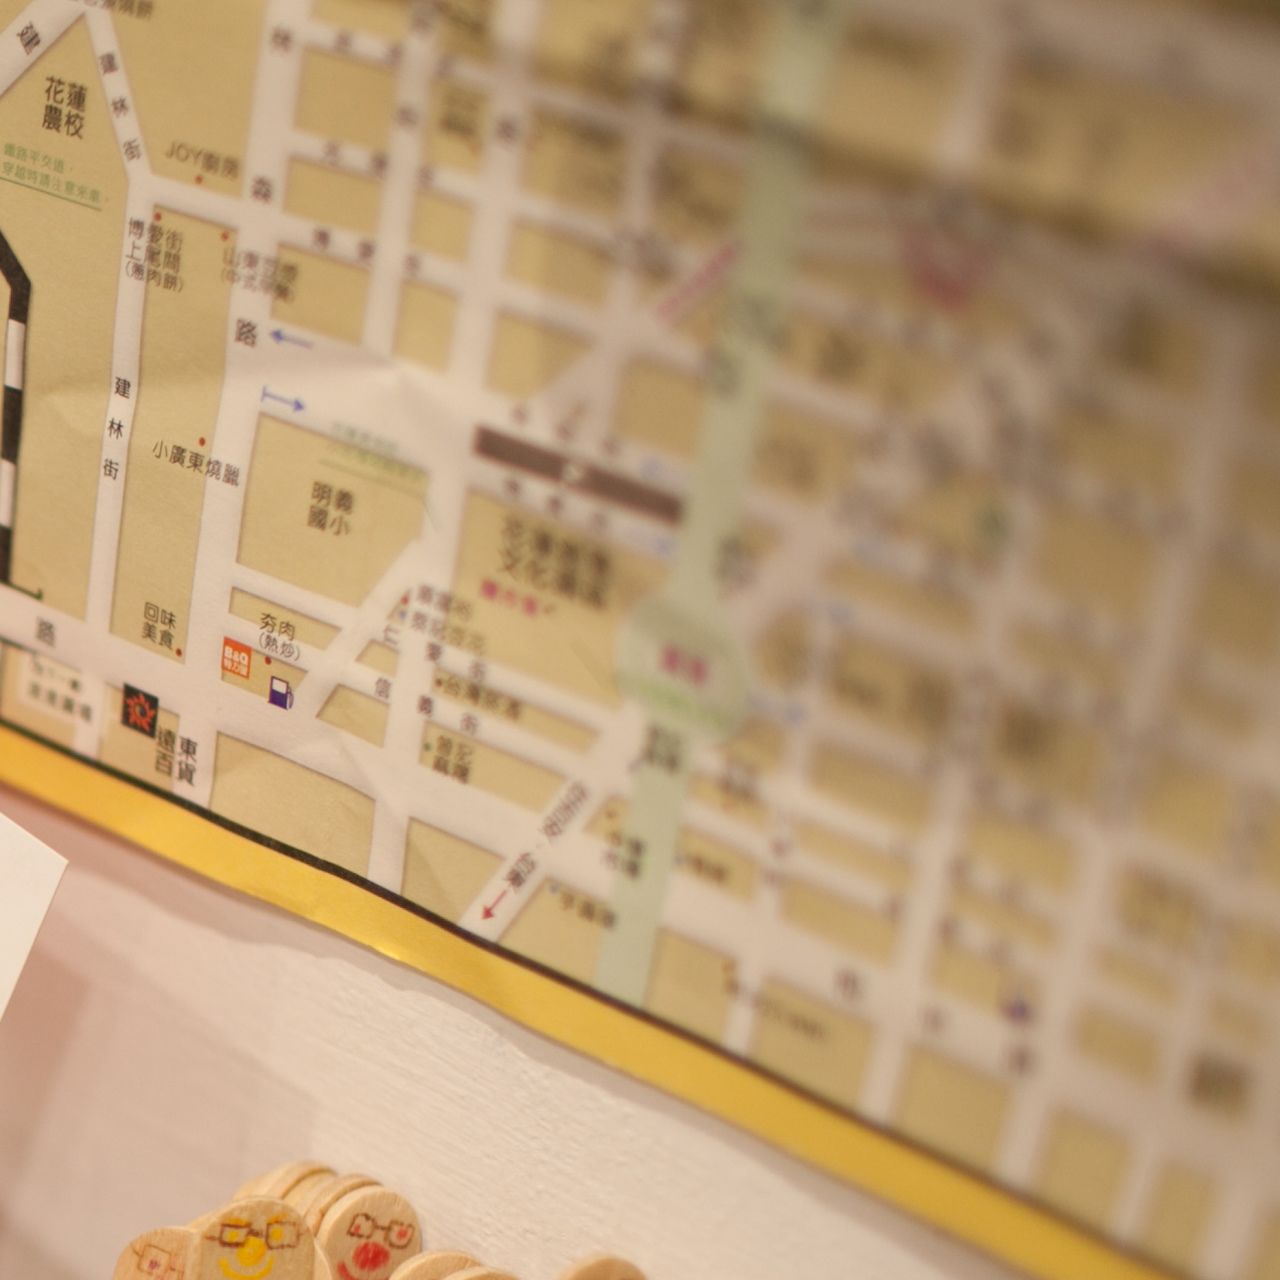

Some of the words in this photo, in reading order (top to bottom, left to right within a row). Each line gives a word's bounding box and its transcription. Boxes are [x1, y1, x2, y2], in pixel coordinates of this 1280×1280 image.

[44, 75, 88, 113] 花蓮
[42, 103, 85, 141] 農校
[103, 376, 131, 481] 建林街
[152, 440, 240, 487] 小廣東燒臘
[143, 601, 176, 630] 回味
[259, 611, 296, 641] 夯肉
[142, 622, 174, 650] 美食
[258, 633, 301, 663] (熱炒)
